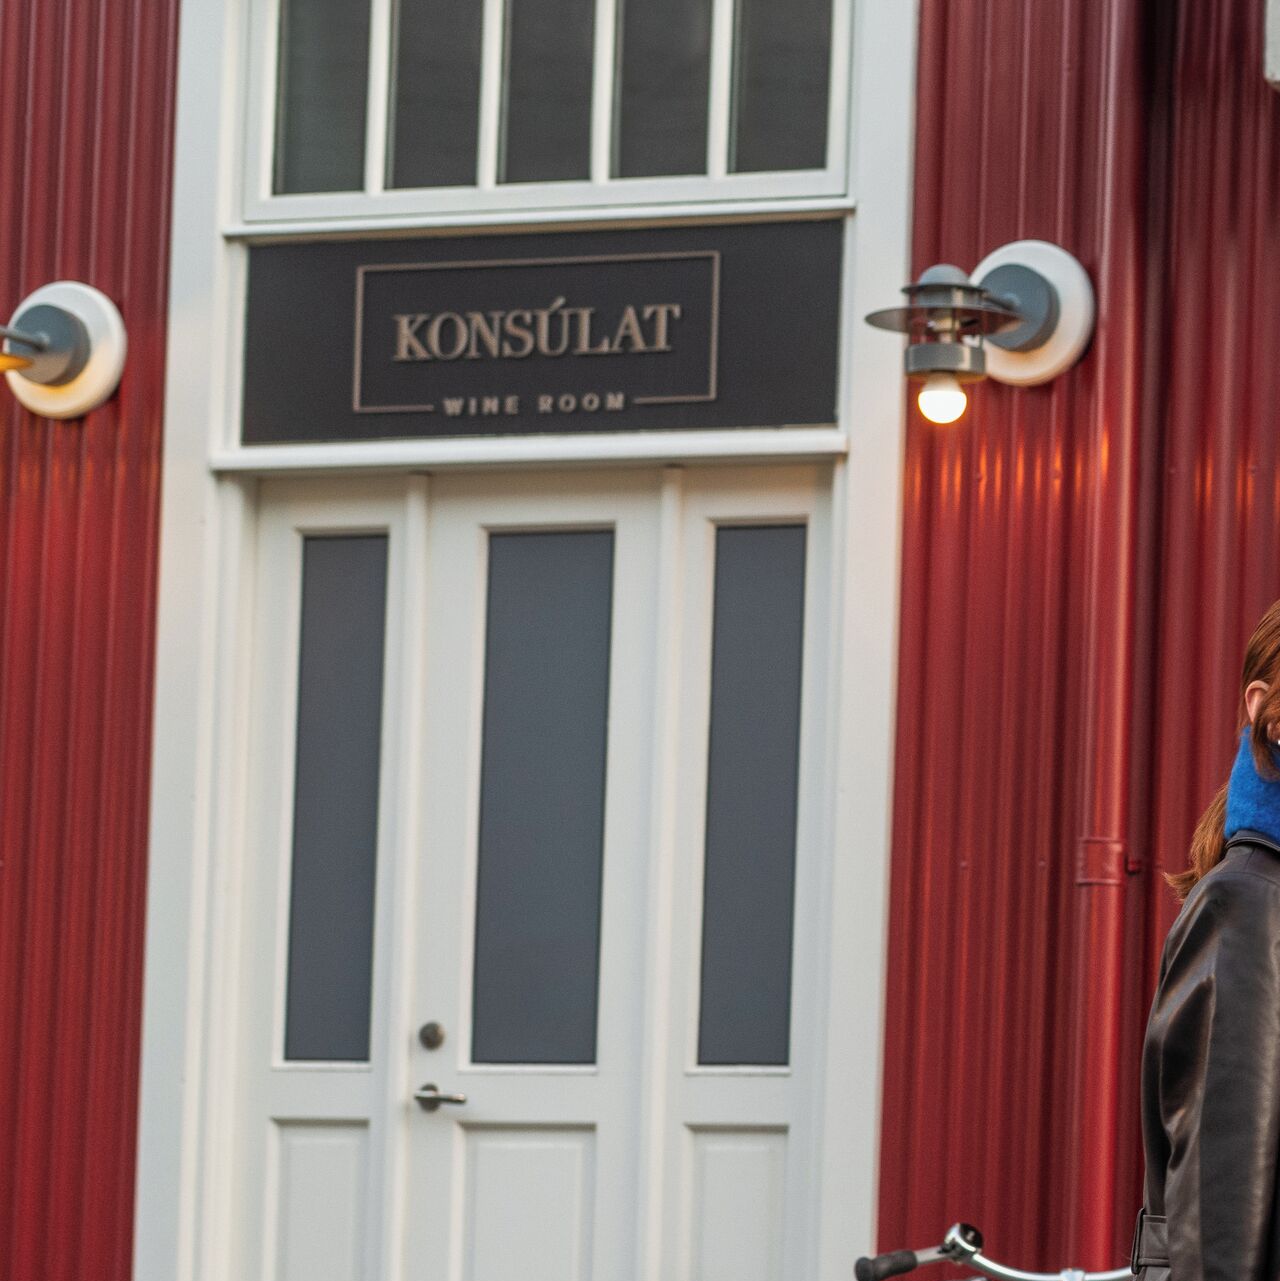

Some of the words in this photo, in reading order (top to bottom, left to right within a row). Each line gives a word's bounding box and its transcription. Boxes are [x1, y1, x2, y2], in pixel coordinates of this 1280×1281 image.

[393, 296, 681, 361] KONSÚLAT
[443, 395, 519, 416] WINE
[538, 392, 625, 414] ROOM
